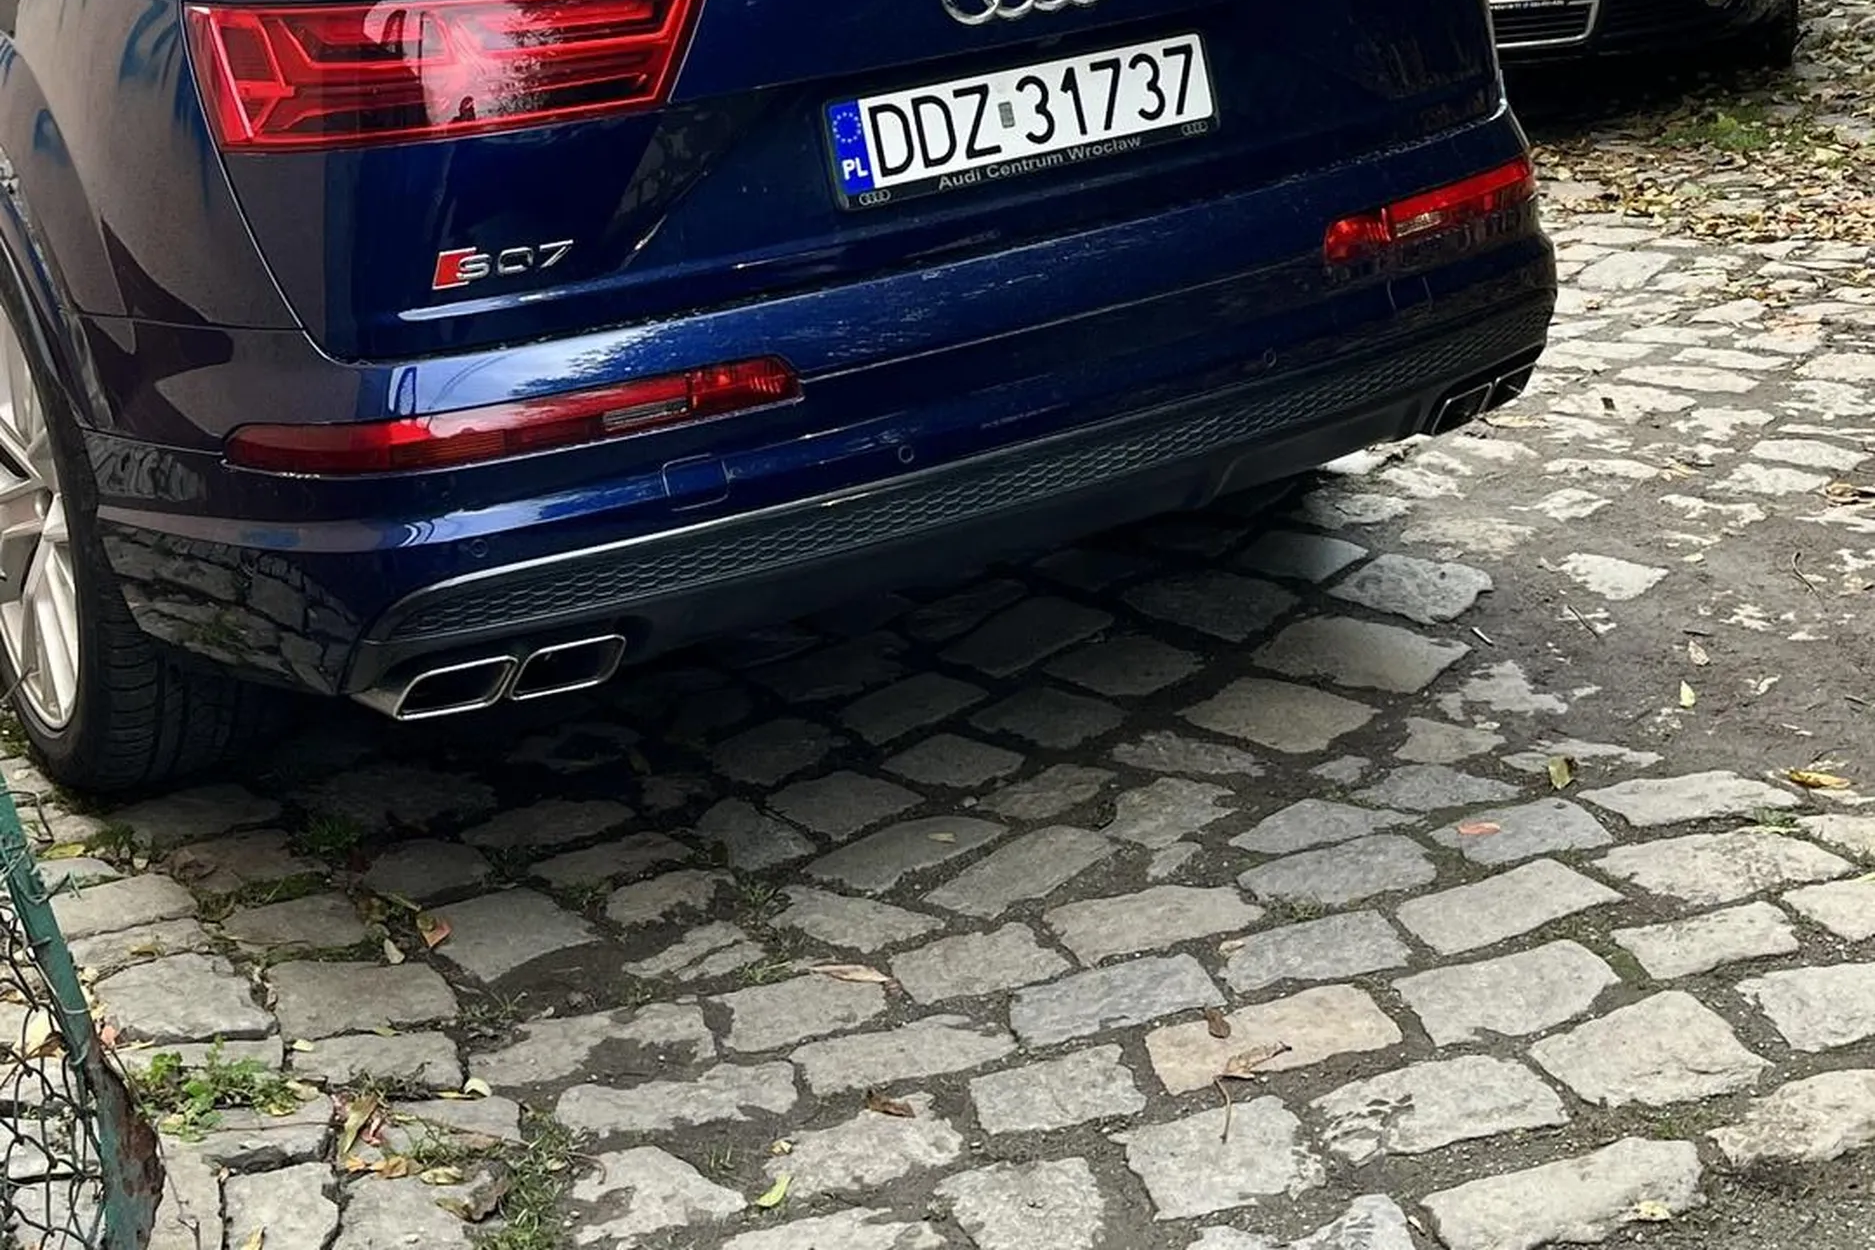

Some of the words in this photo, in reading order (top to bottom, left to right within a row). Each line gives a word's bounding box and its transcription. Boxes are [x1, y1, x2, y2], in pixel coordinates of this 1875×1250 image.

[868, 83, 1002, 178] DDZ
[1016, 44, 1194, 145] 31737
[842, 157, 869, 181] PL
[938, 169, 981, 191] Audi
[986, 153, 1064, 179] Centrum
[454, 239, 574, 281] SQ7
